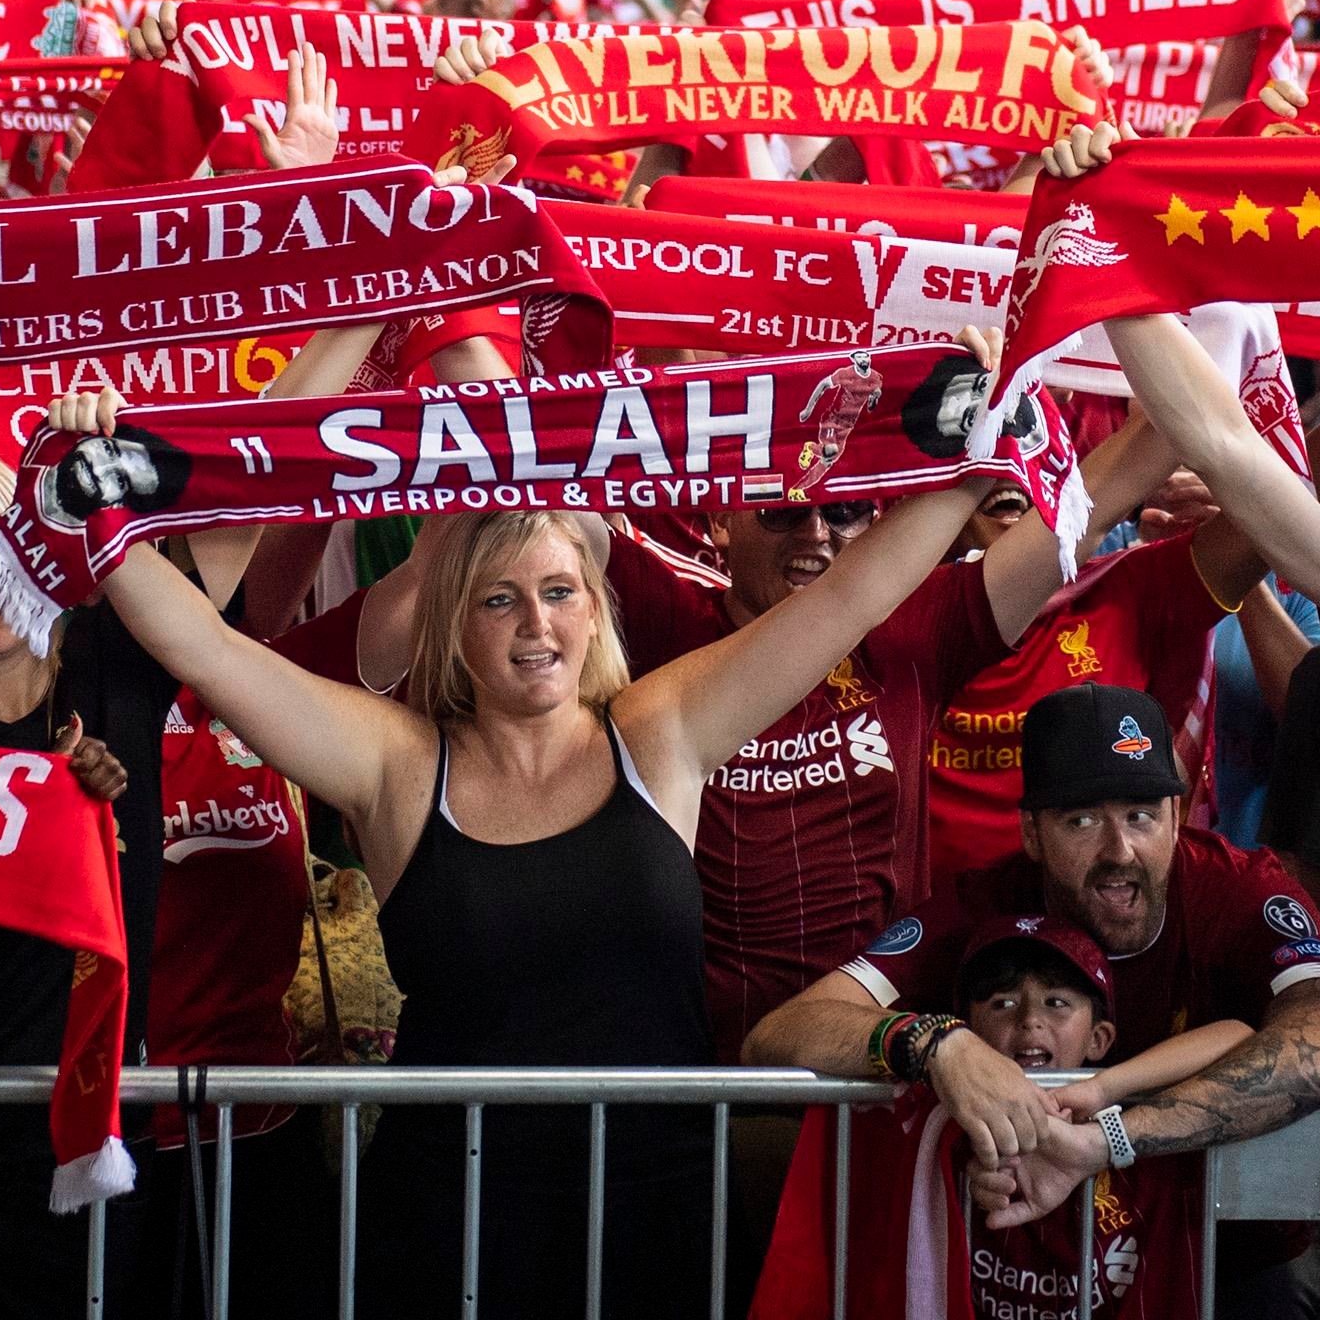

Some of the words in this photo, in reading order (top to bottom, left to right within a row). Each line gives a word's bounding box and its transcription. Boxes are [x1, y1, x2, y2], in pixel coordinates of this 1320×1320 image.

[476, 23, 983, 111] LIVERPOOL
[999, 20, 1097, 113] FC
[528, 89, 649, 133] YOU'LL
[665, 85, 797, 123] NEVER
[814, 88, 930, 127] WALK
[946, 90, 1076, 143] ALONE
[573, 236, 753, 279] ERPOOL
[774, 250, 832, 286] FC
[120, 290, 244, 331] CLUB
[261, 281, 308, 316] IN
[326, 246, 543, 307] LEBANON
[721, 308, 783, 339] 21st
[786, 316, 870, 349] JULY
[418, 367, 654, 401] MOHAMED
[230, 435, 274, 475] 11
[318, 374, 776, 492] SALAH
[312, 481, 548, 519] LIVERPOOL
[562, 482, 590, 508] &
[605, 477, 736, 508] EGYPT
[1, 501, 67, 593] ALAH
[164, 723, 195, 734] didas
[738, 721, 842, 763] andard
[708, 753, 846, 793] hartered
[164, 799, 290, 839] rlsberg
